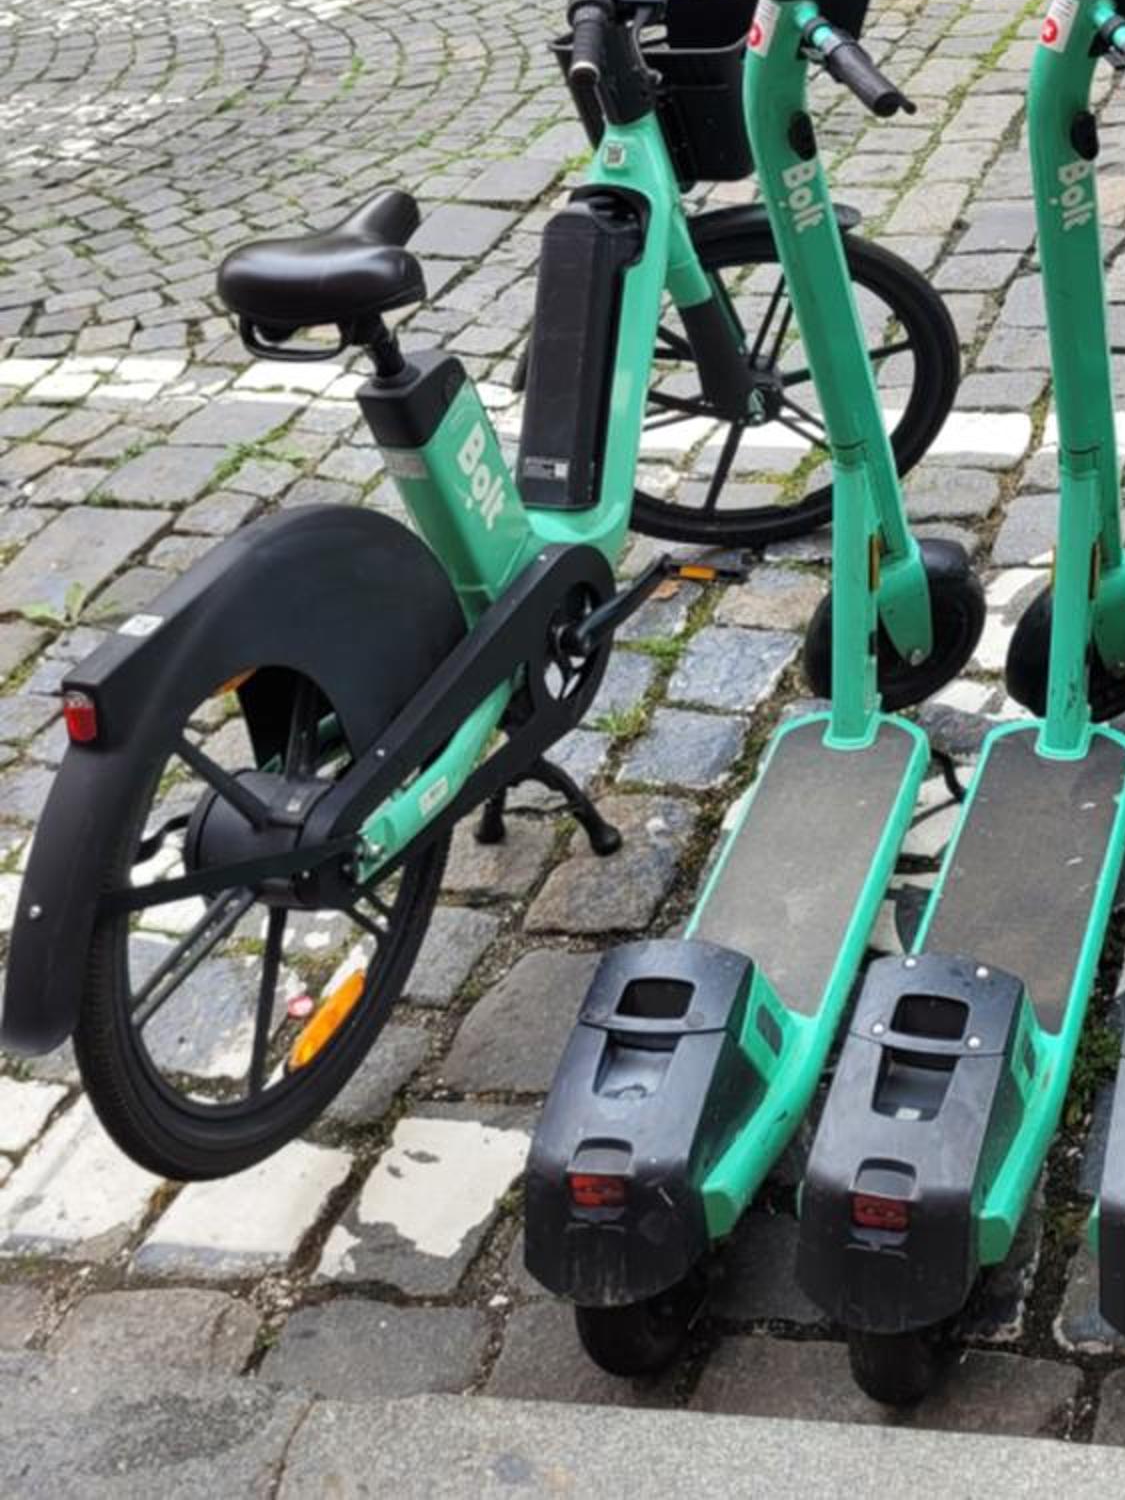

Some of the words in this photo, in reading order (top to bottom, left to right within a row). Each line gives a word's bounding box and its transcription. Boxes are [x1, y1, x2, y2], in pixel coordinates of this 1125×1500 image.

[779, 162, 825, 234] Bolt
[1051, 158, 1095, 232] Bolt
[457, 420, 505, 531] Bolt
